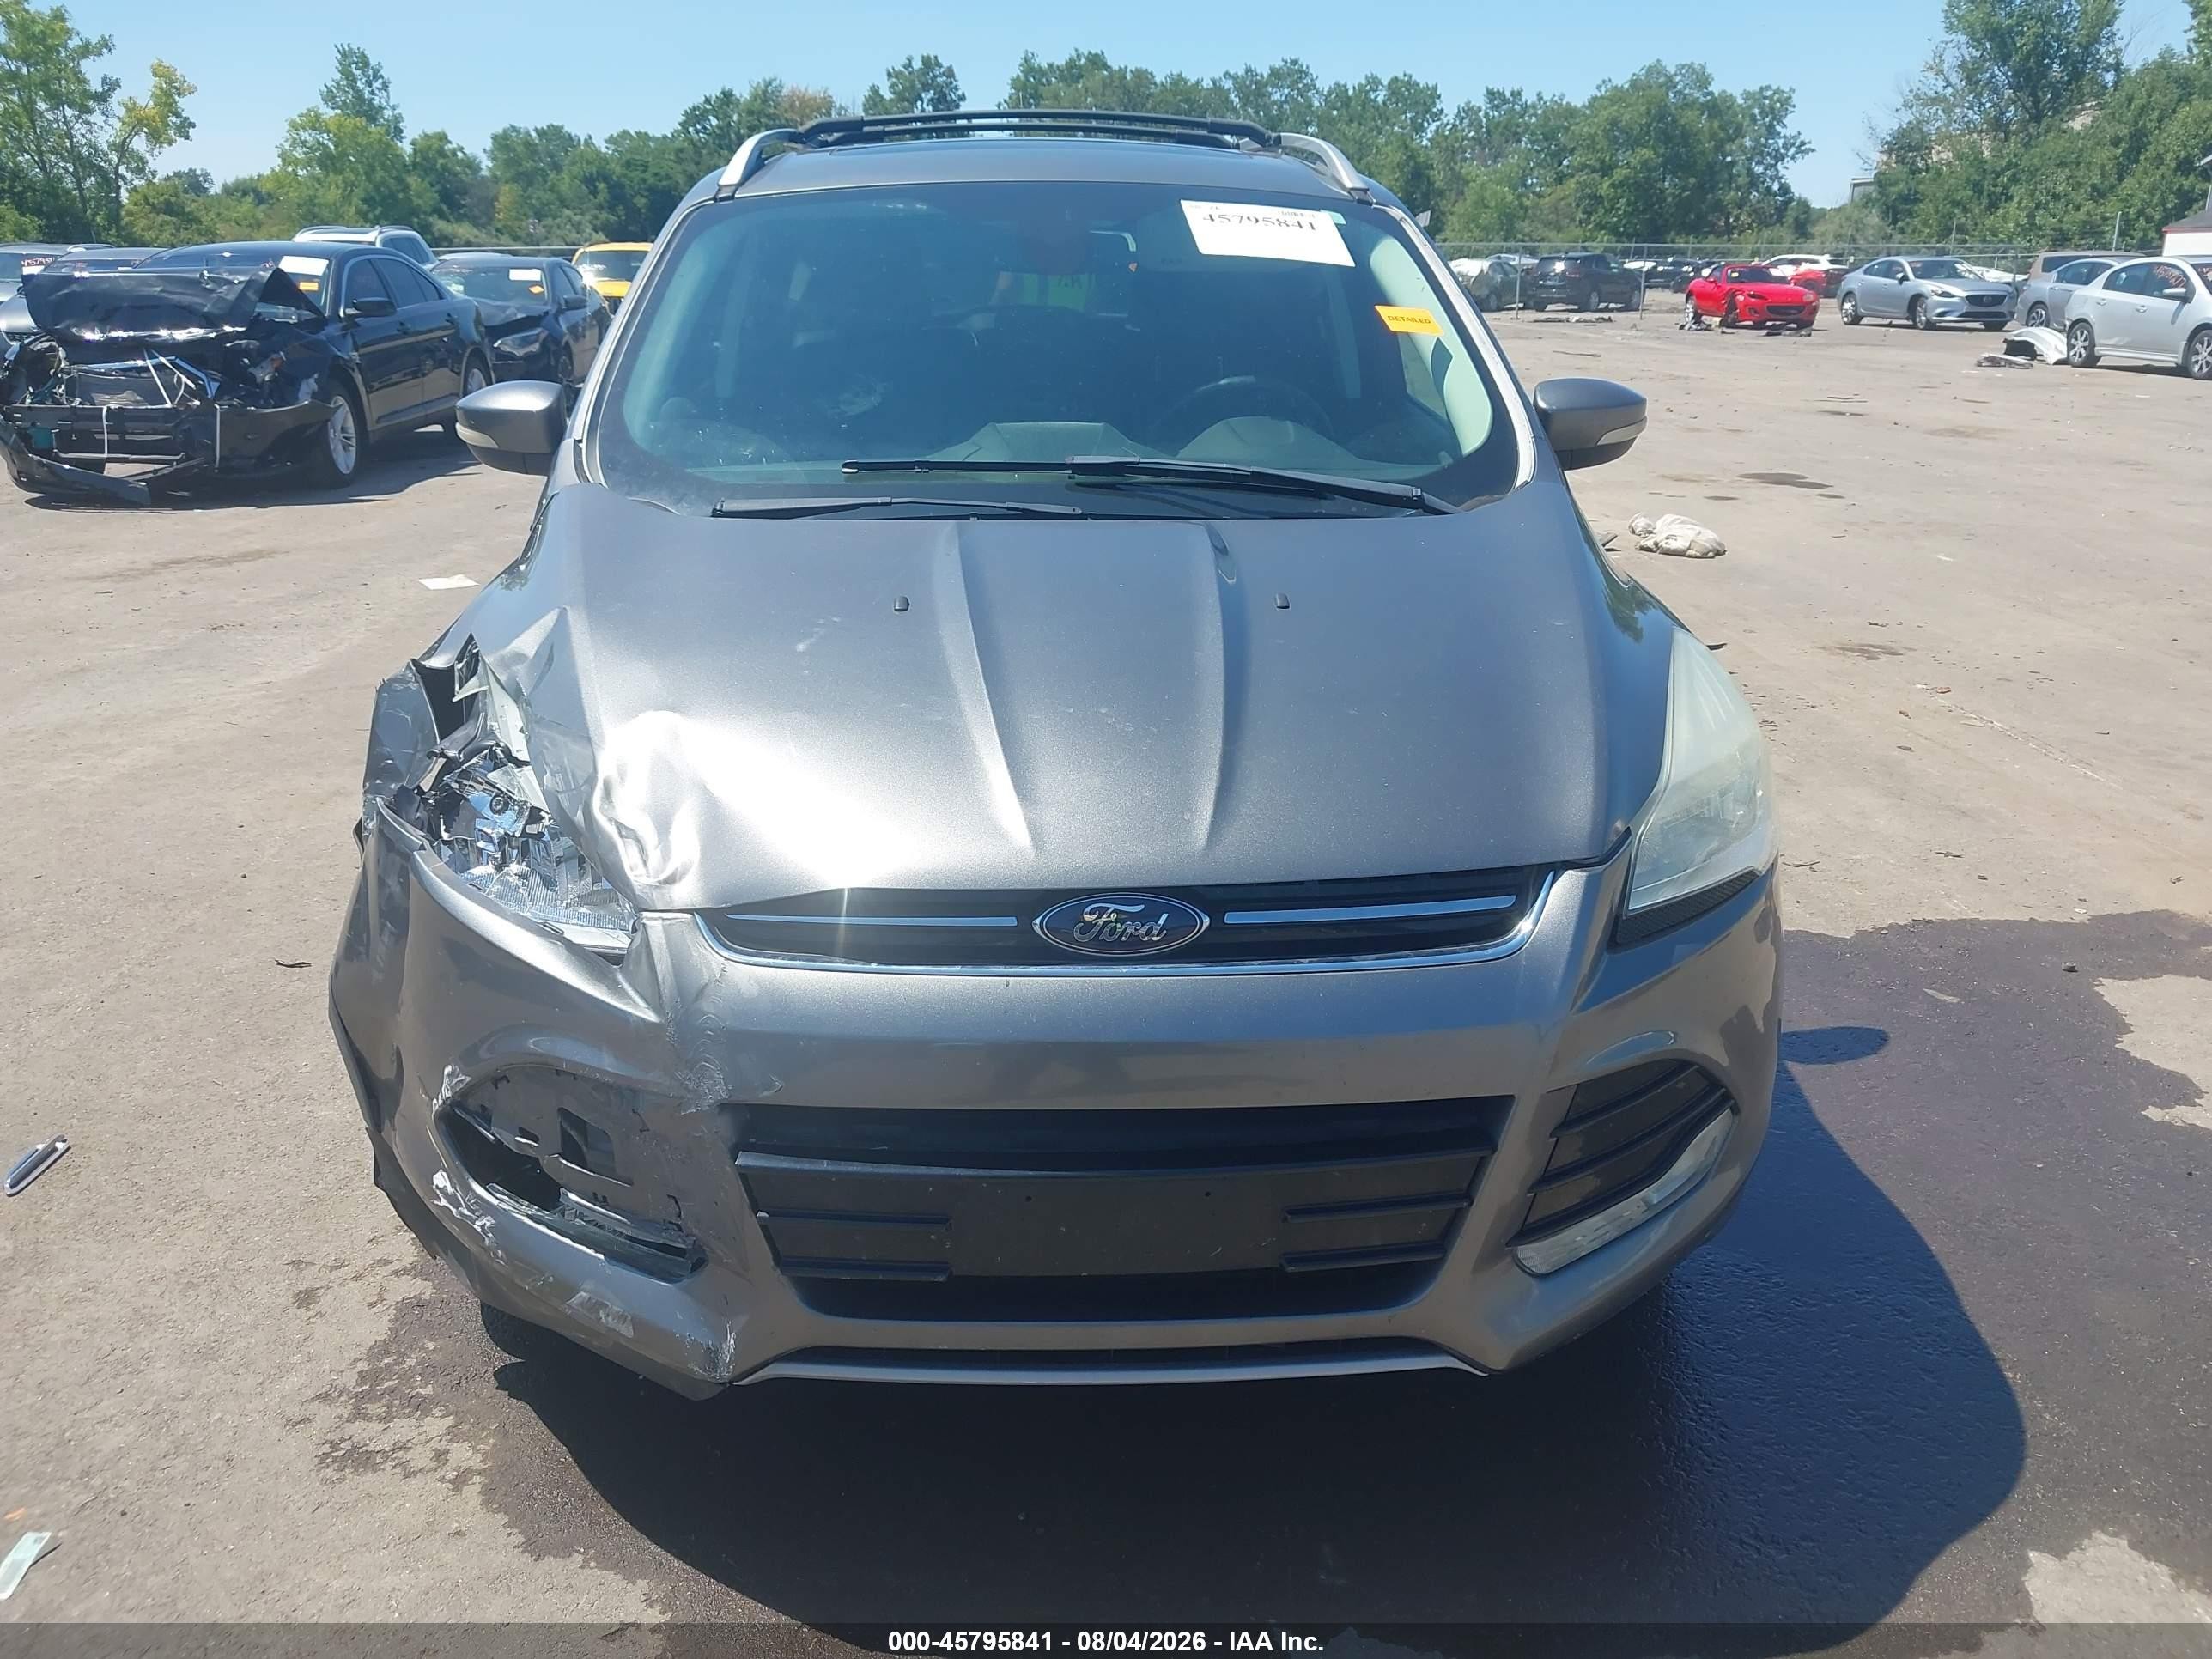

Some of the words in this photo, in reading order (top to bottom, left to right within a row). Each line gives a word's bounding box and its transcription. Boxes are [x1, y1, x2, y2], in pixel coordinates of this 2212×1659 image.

[1202, 213, 1316, 231] 45795841
[1387, 315, 1431, 325] DETAILED
[1073, 902, 1169, 943] Ford
